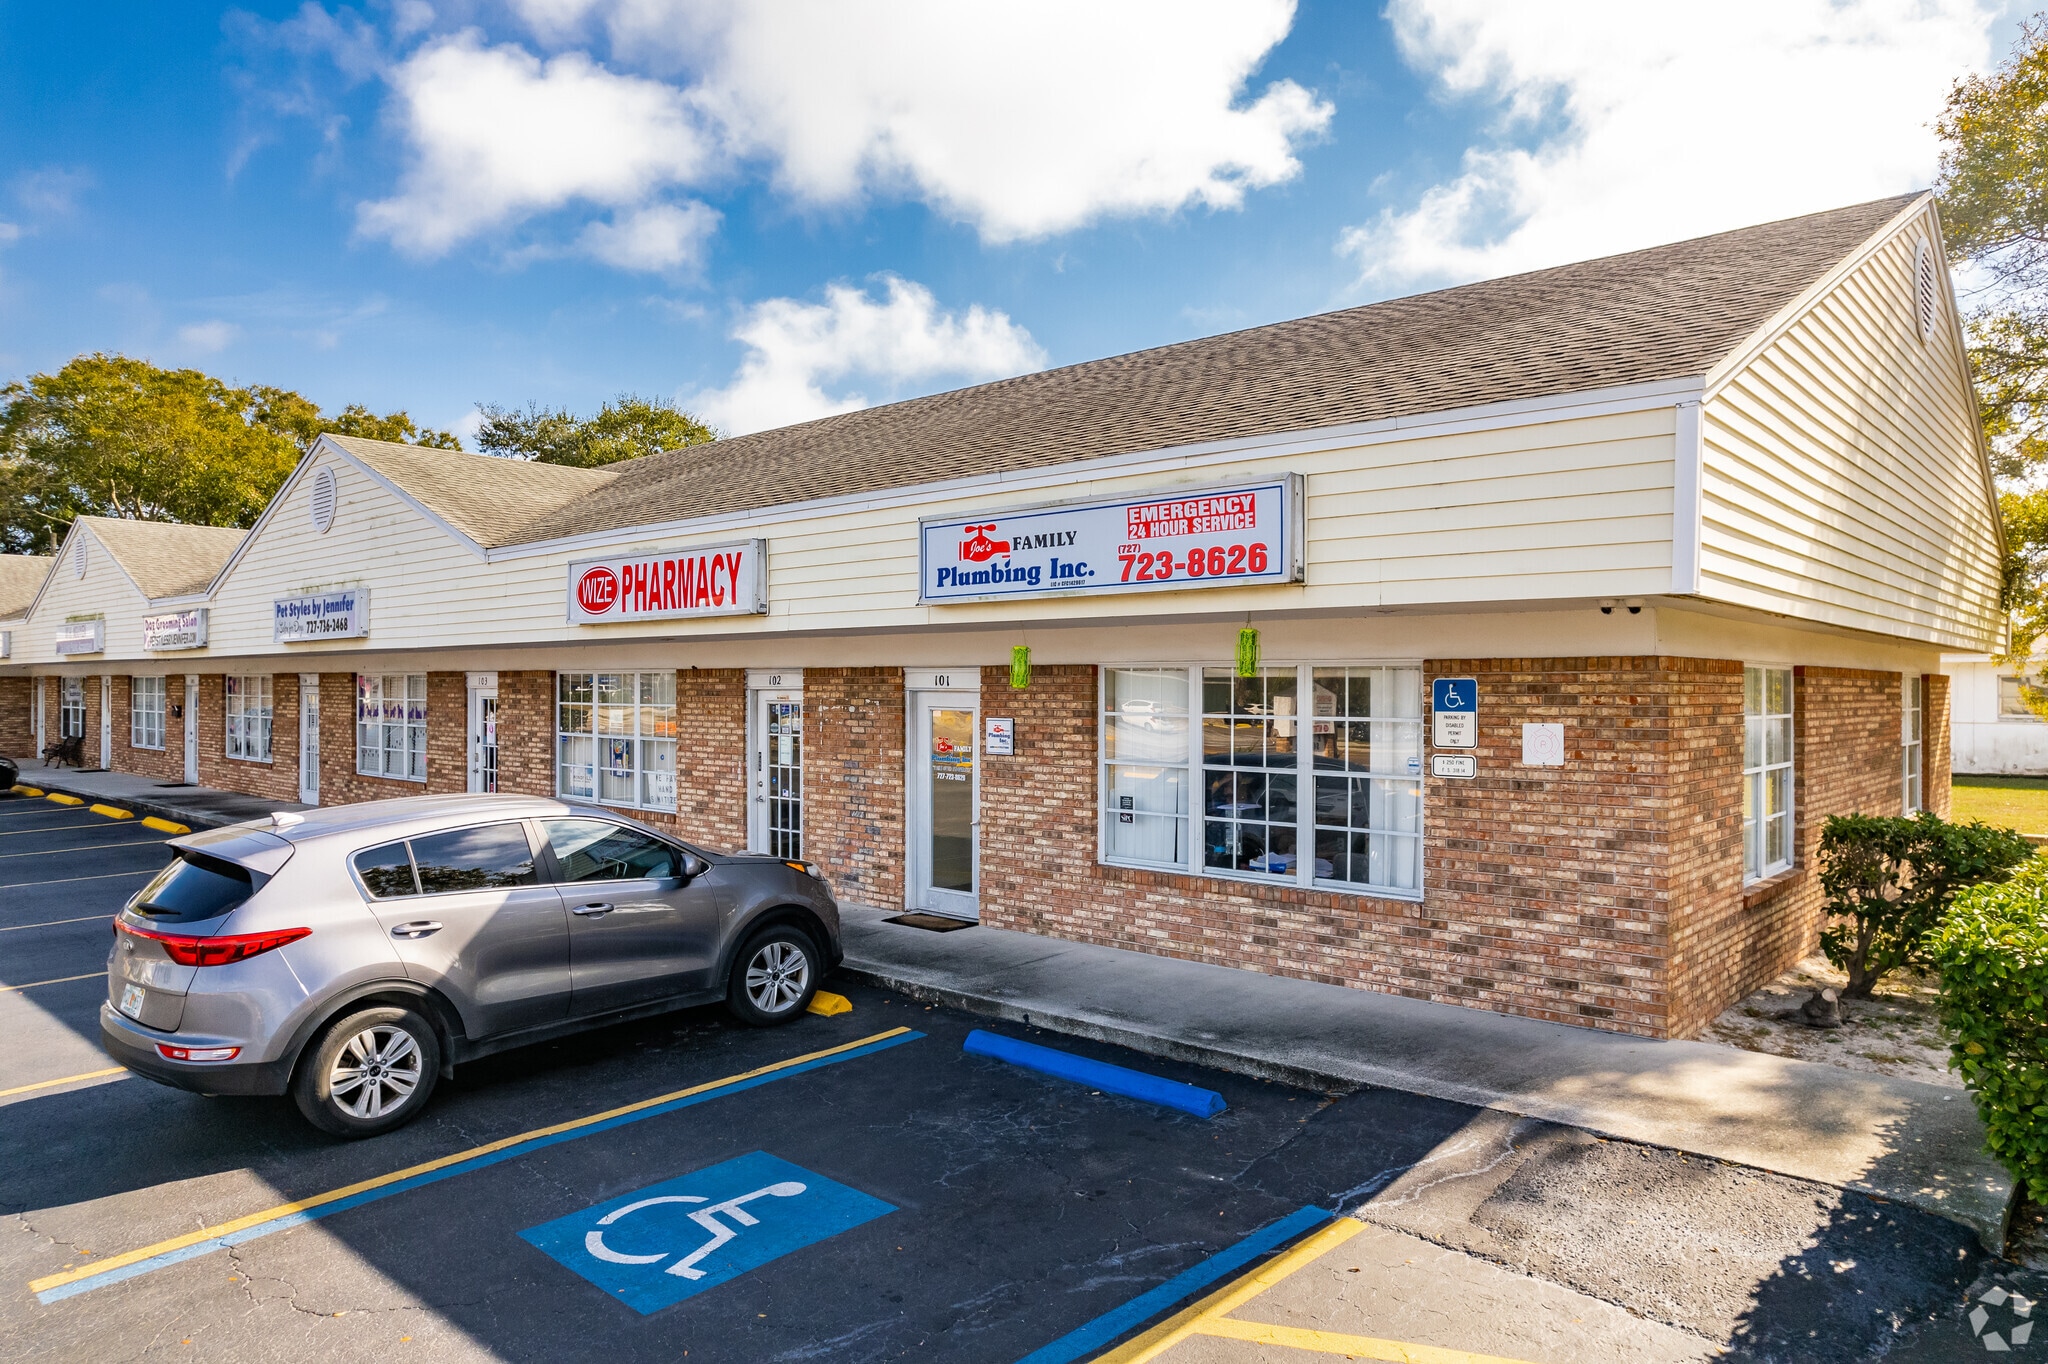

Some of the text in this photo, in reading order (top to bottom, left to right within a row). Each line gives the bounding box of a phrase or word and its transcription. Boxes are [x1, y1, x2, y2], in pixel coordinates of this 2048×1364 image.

[1128, 495, 1254, 524] EMERGENCY
[1128, 511, 1255, 540] 24 HOUR SERVICE
[969, 540, 992, 558] Joe's
[1012, 530, 1078, 551] FAMILY
[1117, 543, 1141, 554] (727)
[936, 557, 1095, 588] Plumbing Inc.
[1117, 542, 1268, 583] 723-8626
[582, 576, 612, 604] WIZE
[621, 551, 743, 613] PHARMACY
[276, 594, 354, 620] Pet Styles by Jennifer
[145, 614, 197, 634] Dog Grooming Salon
[306, 617, 348, 634] 727-736-2468
[478, 676, 488, 685] 103
[768, 675, 781, 686] 102
[934, 675, 950, 687] 101
[988, 732, 1011, 740] Plumbing
